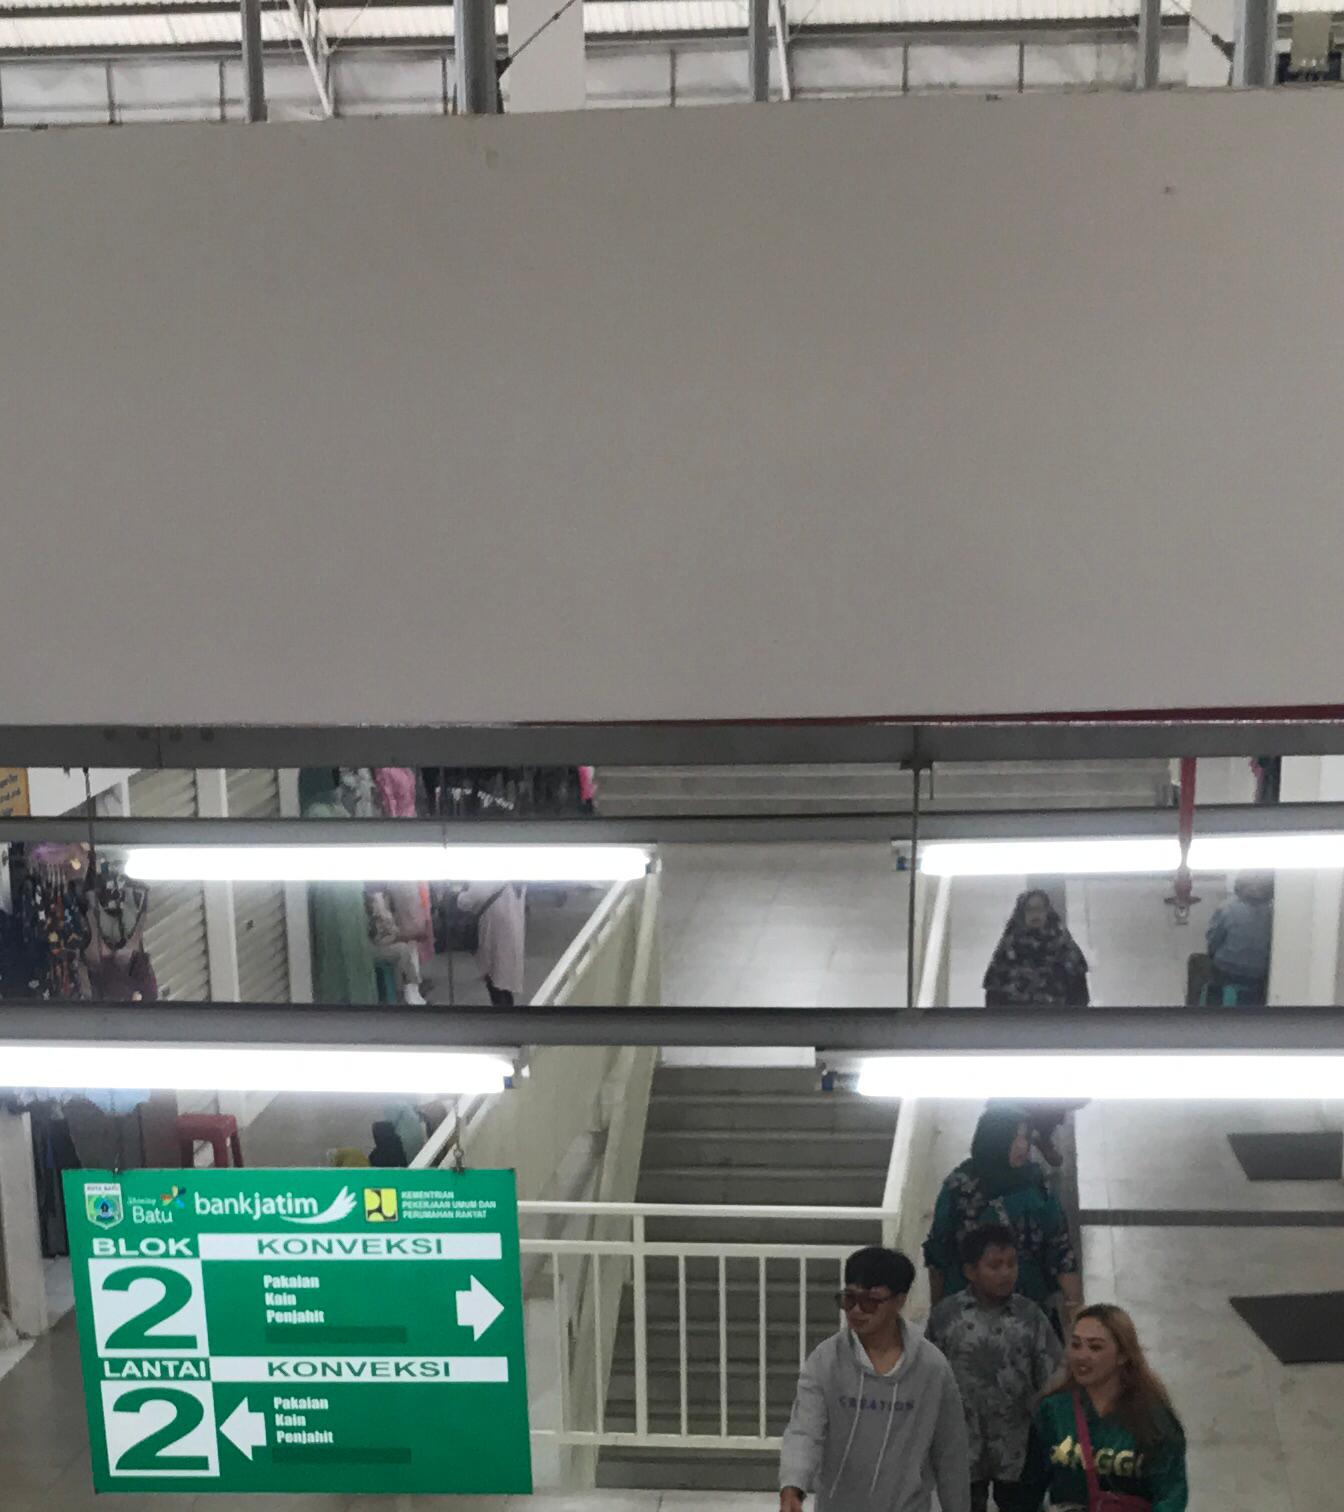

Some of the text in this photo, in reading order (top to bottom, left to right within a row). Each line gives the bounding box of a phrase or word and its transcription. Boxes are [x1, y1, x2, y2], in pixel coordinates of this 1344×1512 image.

[194, 1191, 319, 1219] bankjatim
[478, 1200, 496, 1209] DAN
[132, 1205, 173, 1224] Batu
[92, 1237, 194, 1256] BLOK
[257, 1238, 443, 1255] KONVEKSI
[263, 1274, 320, 1289] Pakaian
[101, 1265, 198, 1350] 2
[265, 1292, 297, 1306] Kain
[266, 1309, 325, 1324] Penjahit
[103, 1360, 206, 1378] LANTAI
[267, 1360, 451, 1378] KONVEKSI
[273, 1396, 329, 1410] Pakaian
[112, 1386, 210, 1470] 2
[275, 1413, 306, 1427] Kain
[276, 1430, 334, 1444] Penjahit
